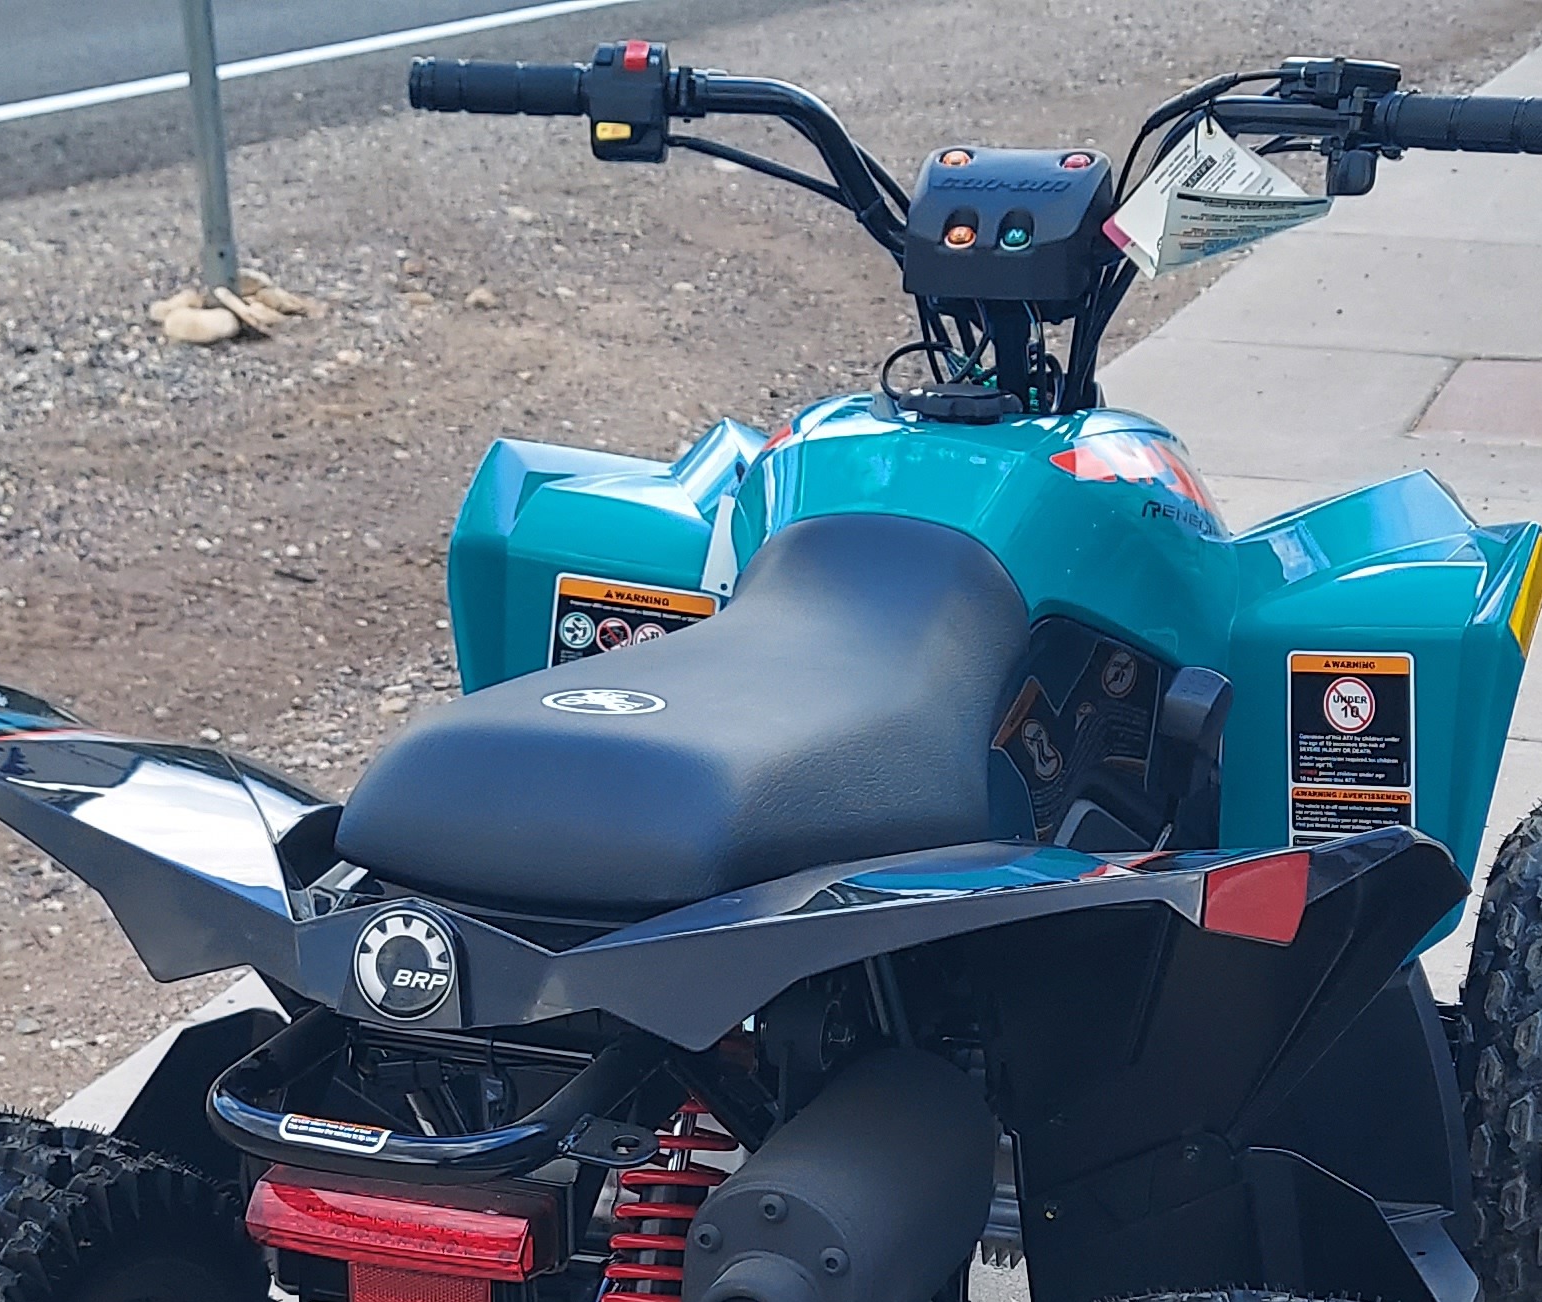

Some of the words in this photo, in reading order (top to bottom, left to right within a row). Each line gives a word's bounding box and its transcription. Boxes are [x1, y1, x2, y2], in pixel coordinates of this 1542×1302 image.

[614, 591, 670, 607] WARNING
[1331, 660, 1376, 670] WARNING
[1332, 694, 1368, 704] UNDER
[1341, 705, 1360, 718] 10
[1343, 792, 1407, 801] AVERTISSEMENT
[392, 969, 448, 991] BRP
